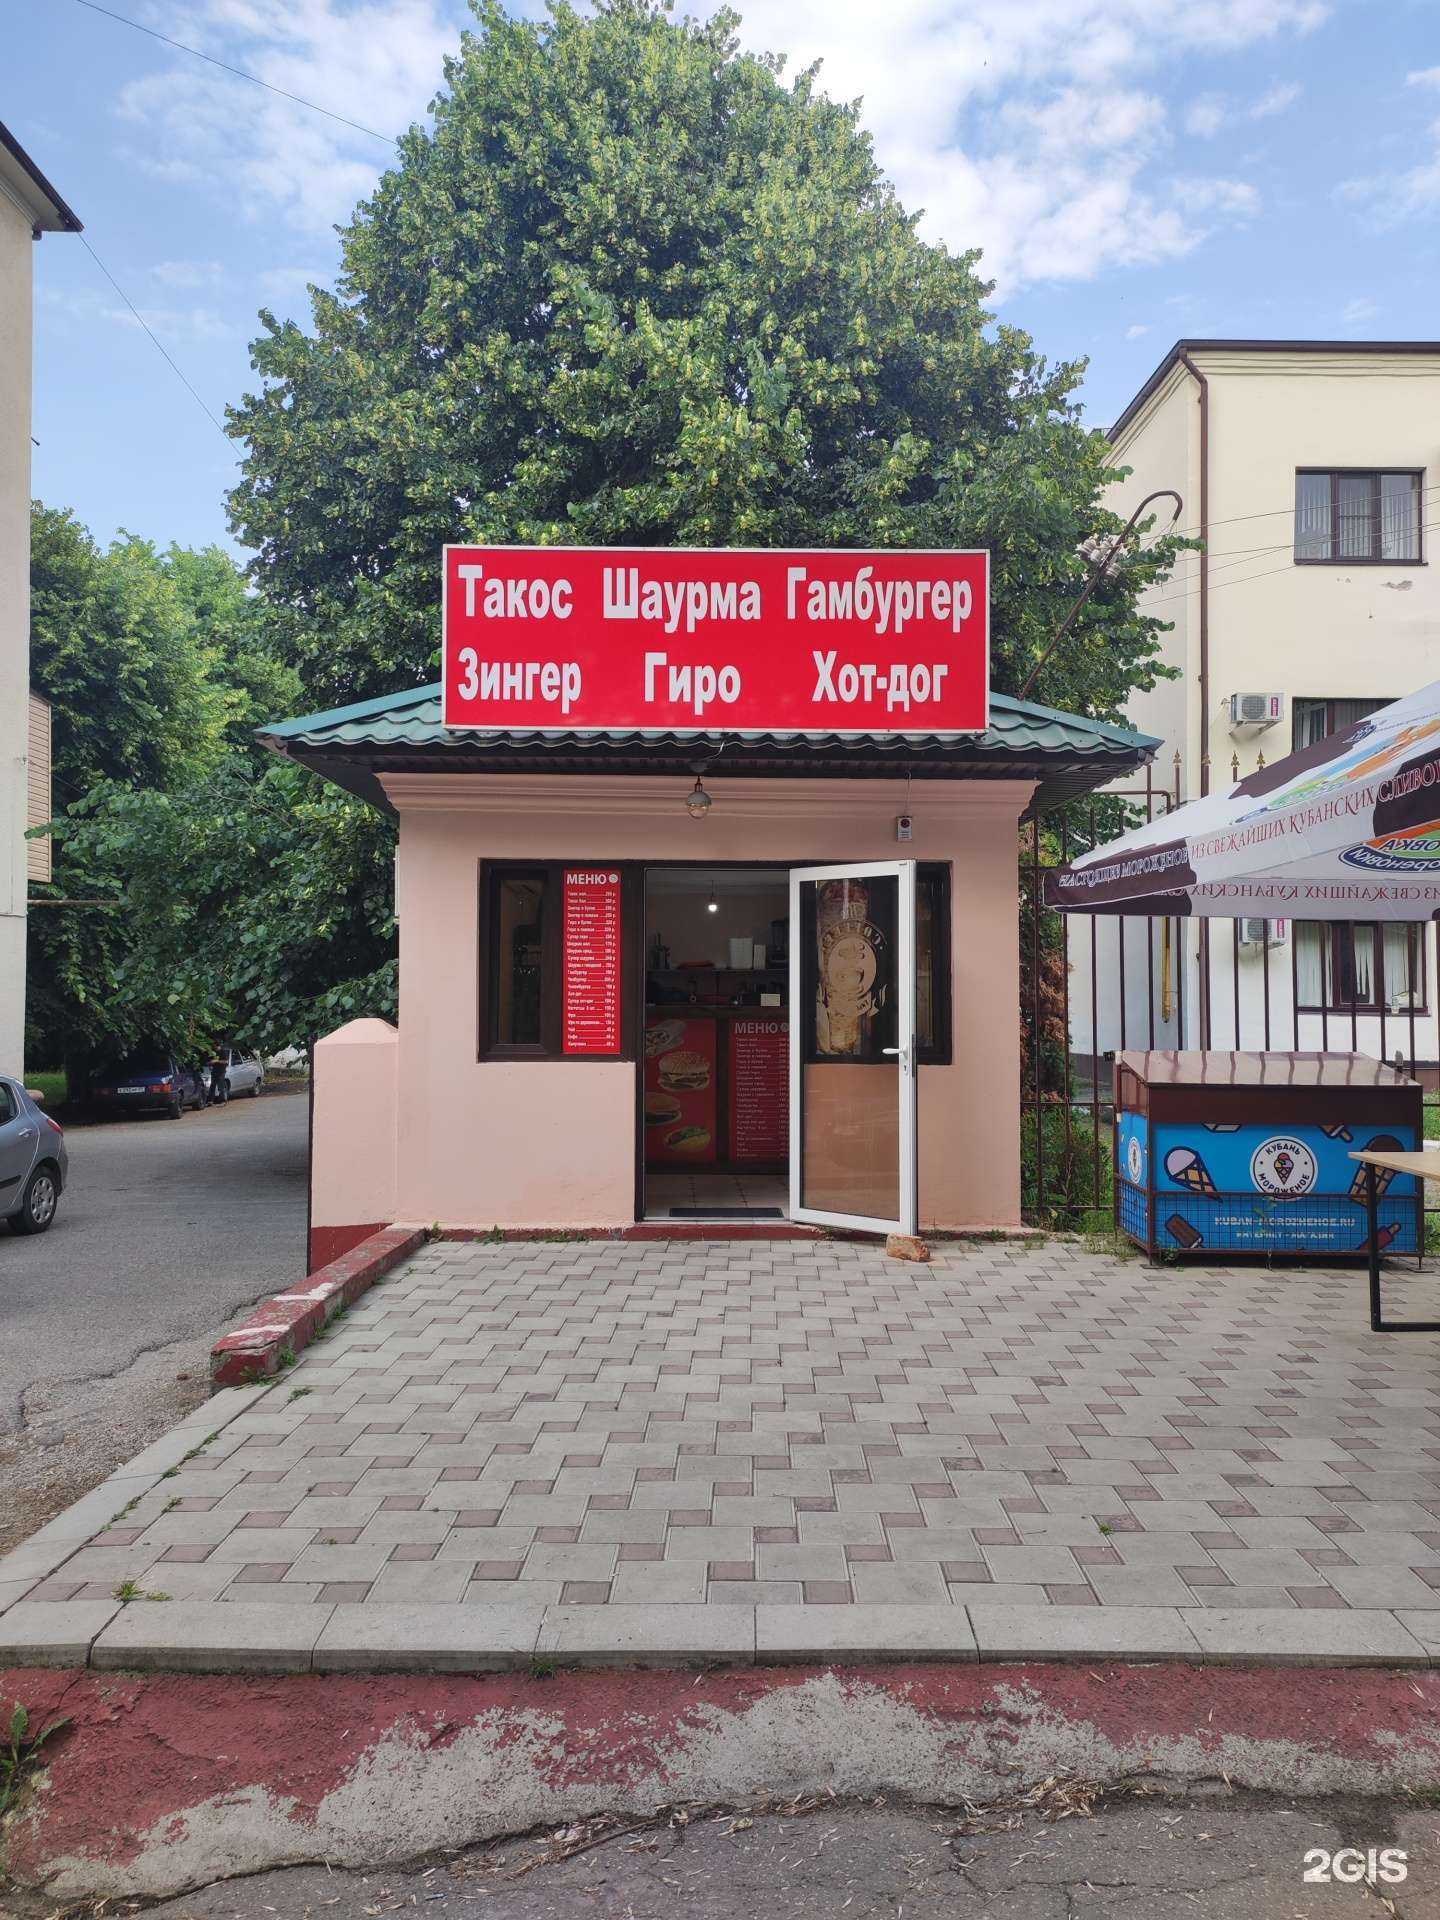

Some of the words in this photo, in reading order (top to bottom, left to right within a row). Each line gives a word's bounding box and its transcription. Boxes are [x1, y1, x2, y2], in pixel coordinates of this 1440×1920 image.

[458, 564, 573, 619] Такос
[603, 567, 761, 633] Шаурма
[786, 566, 973, 634] Гамбургер
[457, 648, 582, 714] Зингер
[645, 653, 741, 716] Гиро
[812, 650, 948, 712] Хот-дог
[1191, 844, 1204, 860] ИЗ
[1206, 819, 1286, 856] СВЕЖАЙШИХ
[1289, 786, 1376, 834] КУБАНСКИХ
[567, 874, 607, 885] МЕНЮ
[735, 1022, 778, 1034] МЕНЮ
[1265, 1143, 1301, 1156] КУБАНЬ
[1258, 1172, 1310, 1195] МОРОЖЕНОЕ
